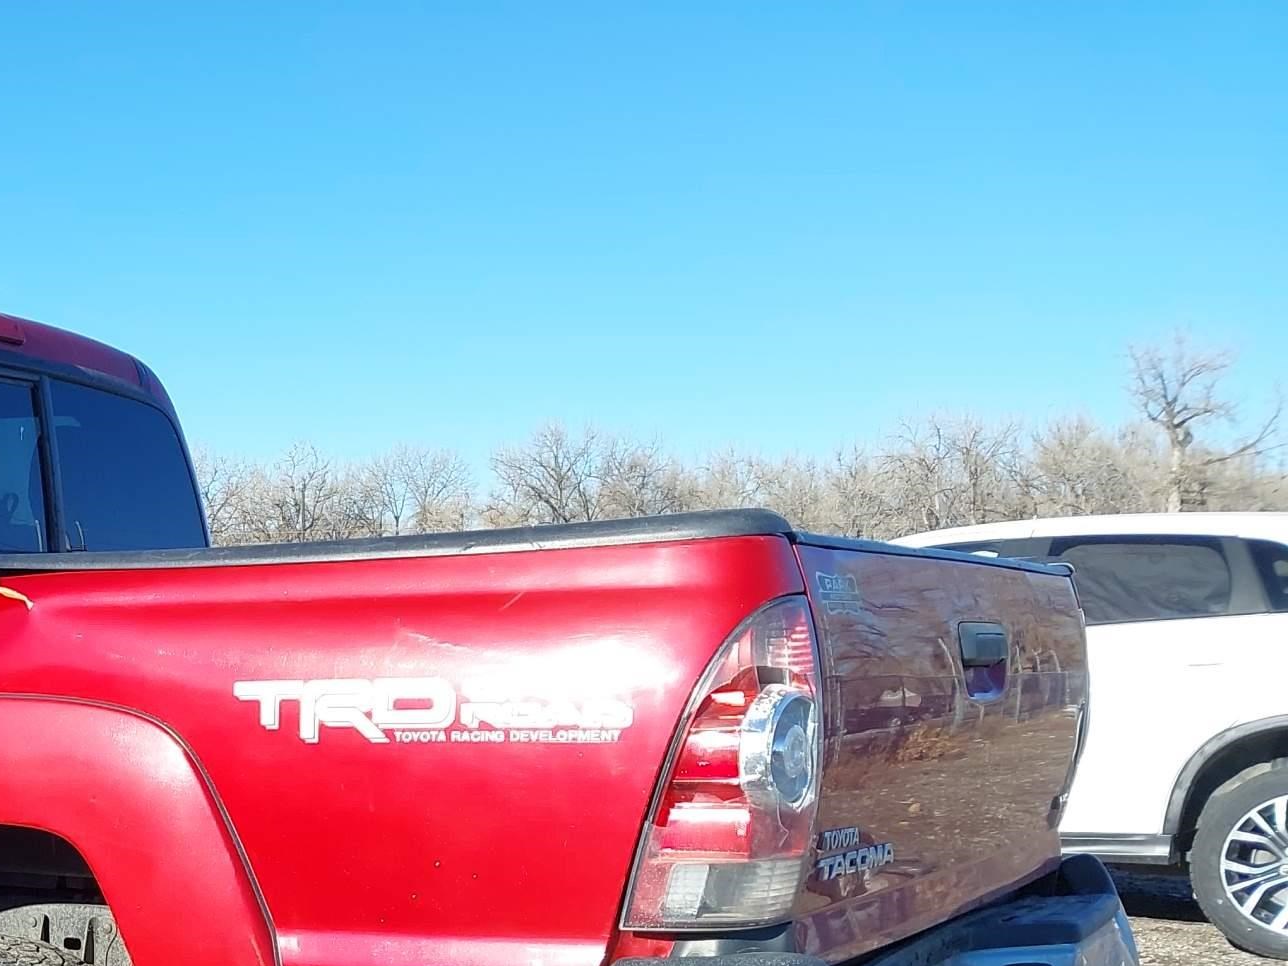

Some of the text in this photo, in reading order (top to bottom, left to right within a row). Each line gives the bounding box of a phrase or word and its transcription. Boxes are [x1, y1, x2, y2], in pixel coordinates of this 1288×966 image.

[232, 677, 456, 744] TRD
[394, 729, 622, 743] TOYOTA RACING DEVELOPMENT
[823, 827, 860, 851] TOYOTA
[816, 843, 894, 880] TACOMA
